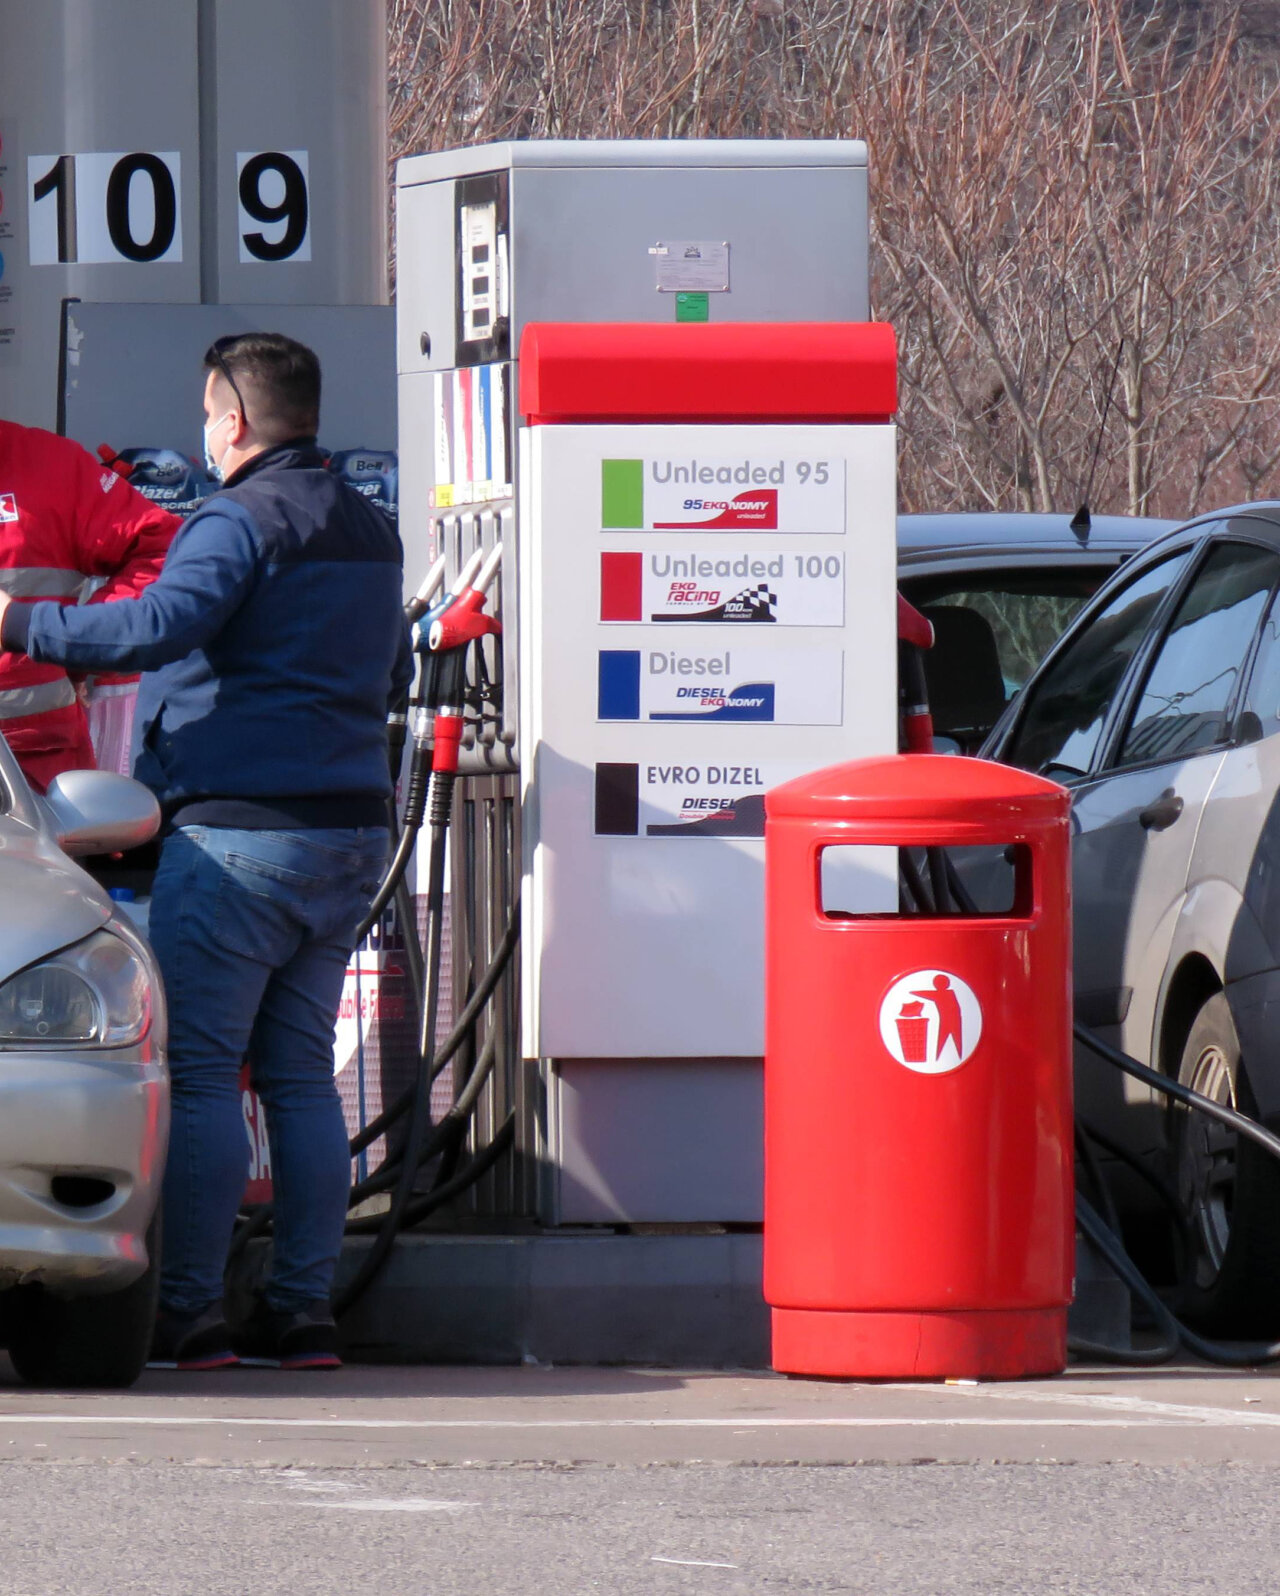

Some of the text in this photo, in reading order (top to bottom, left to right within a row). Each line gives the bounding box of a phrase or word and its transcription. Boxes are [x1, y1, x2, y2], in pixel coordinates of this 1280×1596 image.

[32, 151, 309, 264] 10 9
[651, 460, 830, 485] Unleaded 95
[651, 553, 841, 579] Unleaded 100
[670, 582, 697, 591] EKO
[666, 590, 721, 606] racing
[649, 651, 731, 675] Diesel
[676, 687, 727, 698] DIESEL
[700, 697, 765, 707] EKONOMY
[647, 766, 764, 785] EVRO DIZEL
[681, 798, 736, 809] DIESEL
